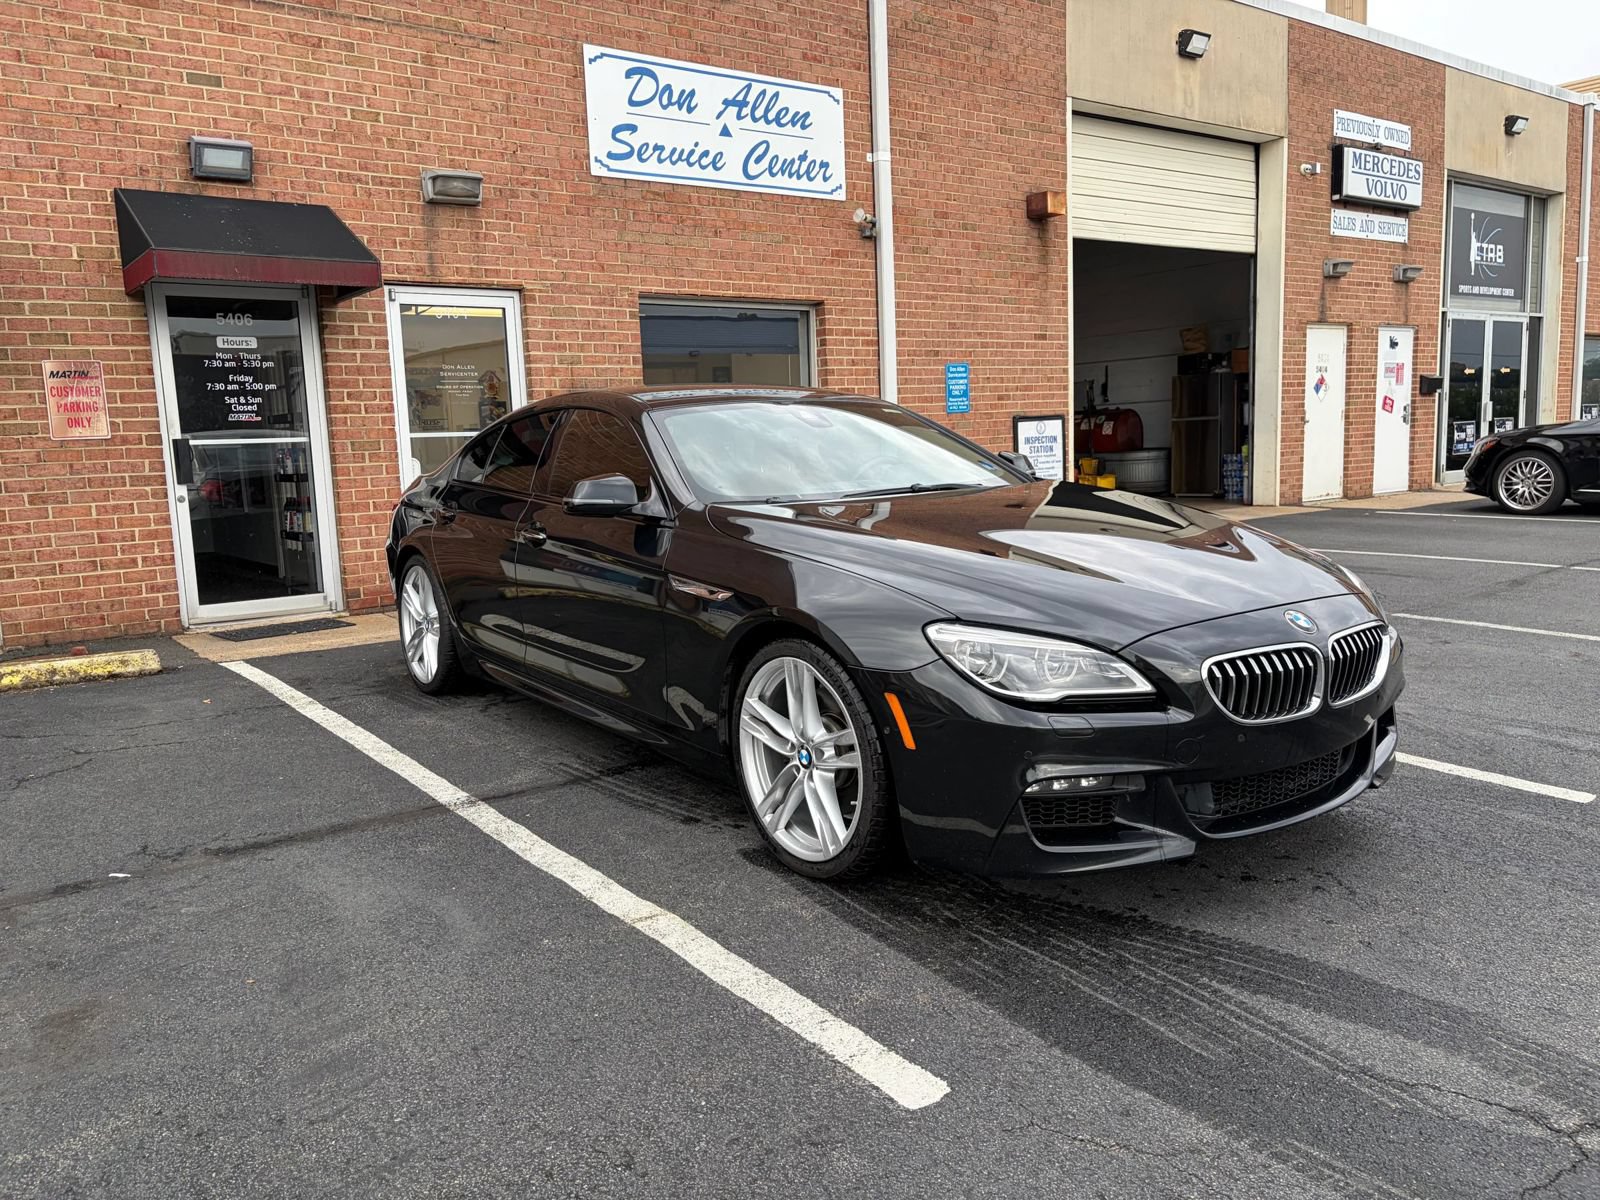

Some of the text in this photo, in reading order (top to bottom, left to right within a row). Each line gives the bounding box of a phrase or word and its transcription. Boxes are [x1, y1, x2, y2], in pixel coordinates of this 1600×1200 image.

[625, 66, 813, 131] Don Allen
[1336, 116, 1410, 145] PREVIOUSLY OWNED
[607, 123, 833, 182] Service Center
[1352, 151, 1421, 181] MERCEDES
[1366, 178, 1408, 201] VOLVO
[1333, 215, 1406, 237] SALES AND SERVICE
[215, 312, 253, 326] 5406
[222, 338, 252, 347] Hours:
[215, 352, 233, 360] Mon
[239, 352, 261, 360] Thurs
[203, 360, 223, 368] 7:30
[243, 360, 261, 368] 5:30
[262, 361, 275, 369] pm
[49, 370, 89, 379] MARTIN
[229, 374, 253, 383] Friday
[49, 386, 101, 398] CUSTOMER
[206, 383, 225, 391] 7:30
[245, 383, 263, 391] 5:00
[265, 384, 277, 392] pm
[224, 396, 262, 404] Sat & Sun
[57, 401, 99, 413] PARKING
[231, 403, 258, 411] Closed
[67, 416, 92, 429] ONLY
[1024, 435, 1057, 445] INSPECTION
[1029, 445, 1054, 454] STATION
